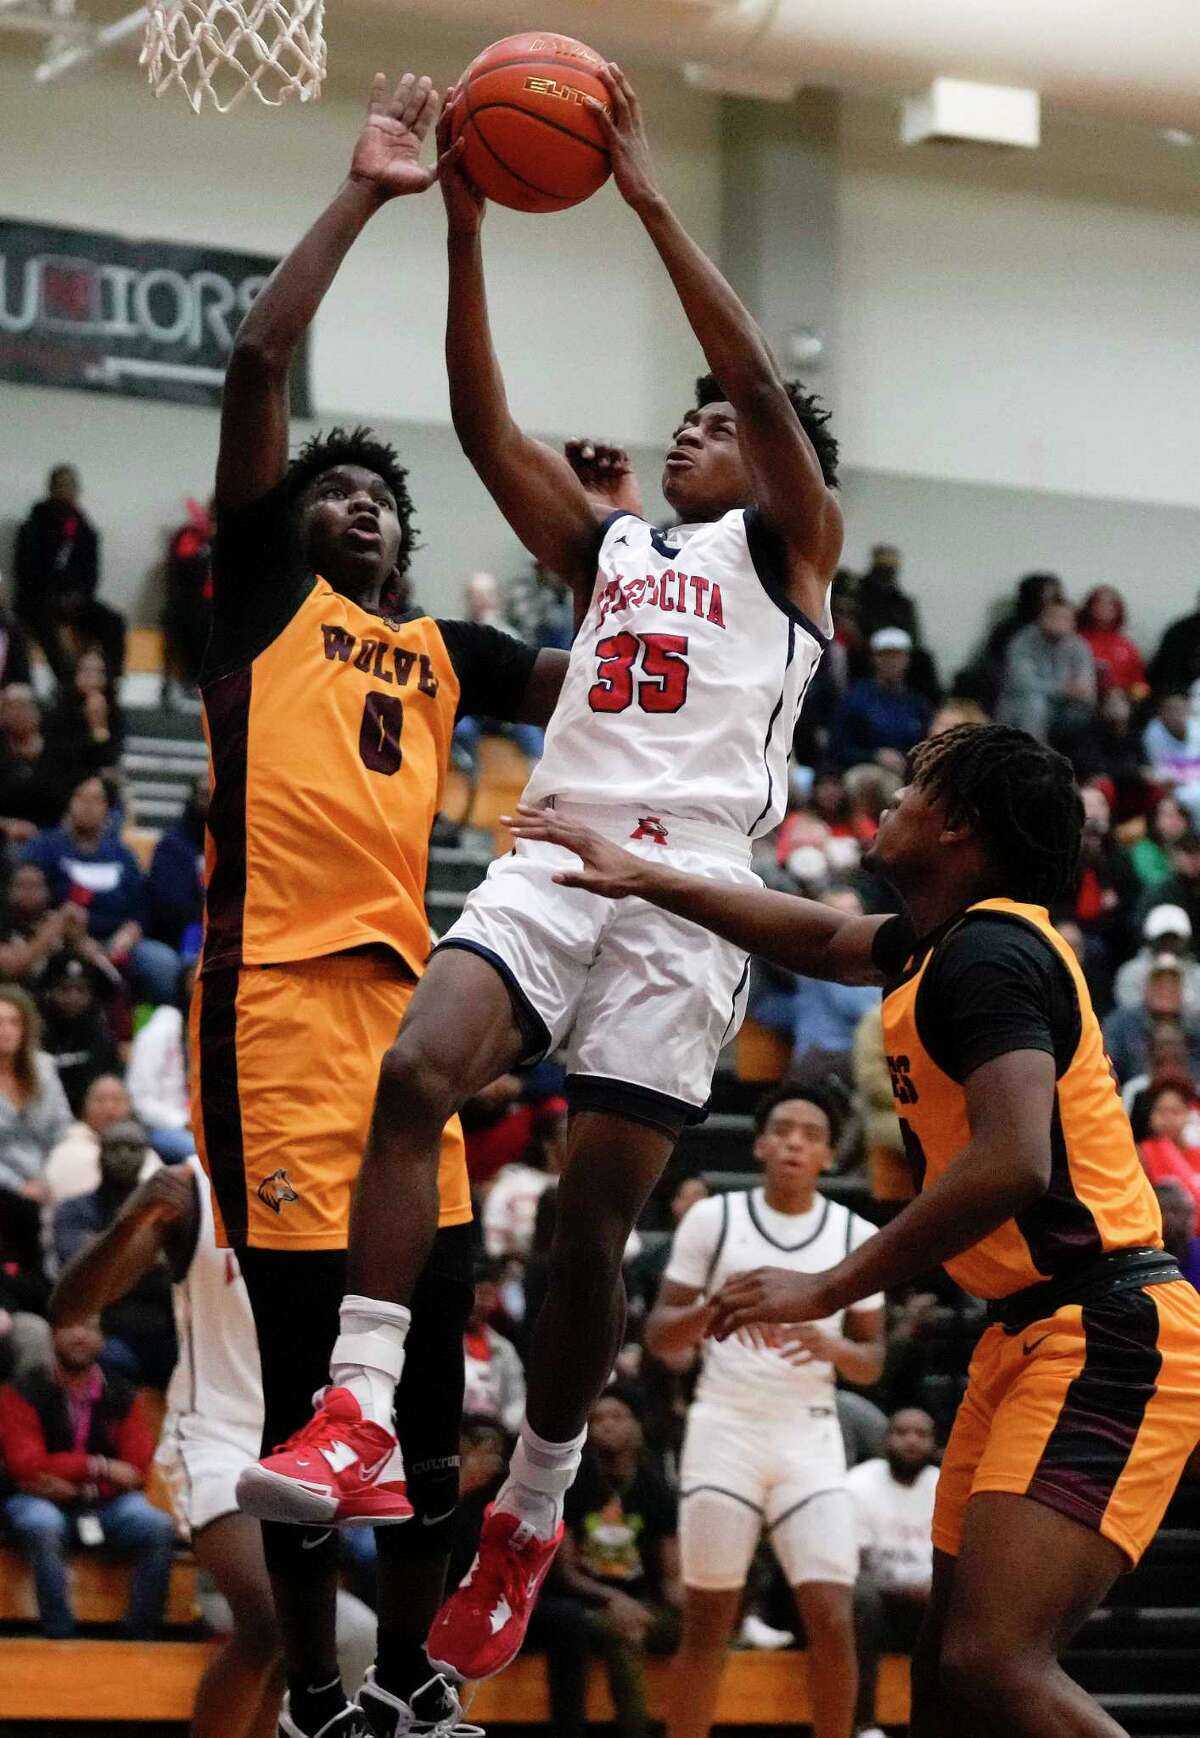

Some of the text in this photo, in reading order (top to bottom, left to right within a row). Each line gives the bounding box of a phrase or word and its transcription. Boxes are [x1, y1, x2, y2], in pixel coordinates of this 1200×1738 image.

[522, 76, 612, 118] ELIT
[588, 631, 690, 714] 35
[359, 690, 404, 777] 0
